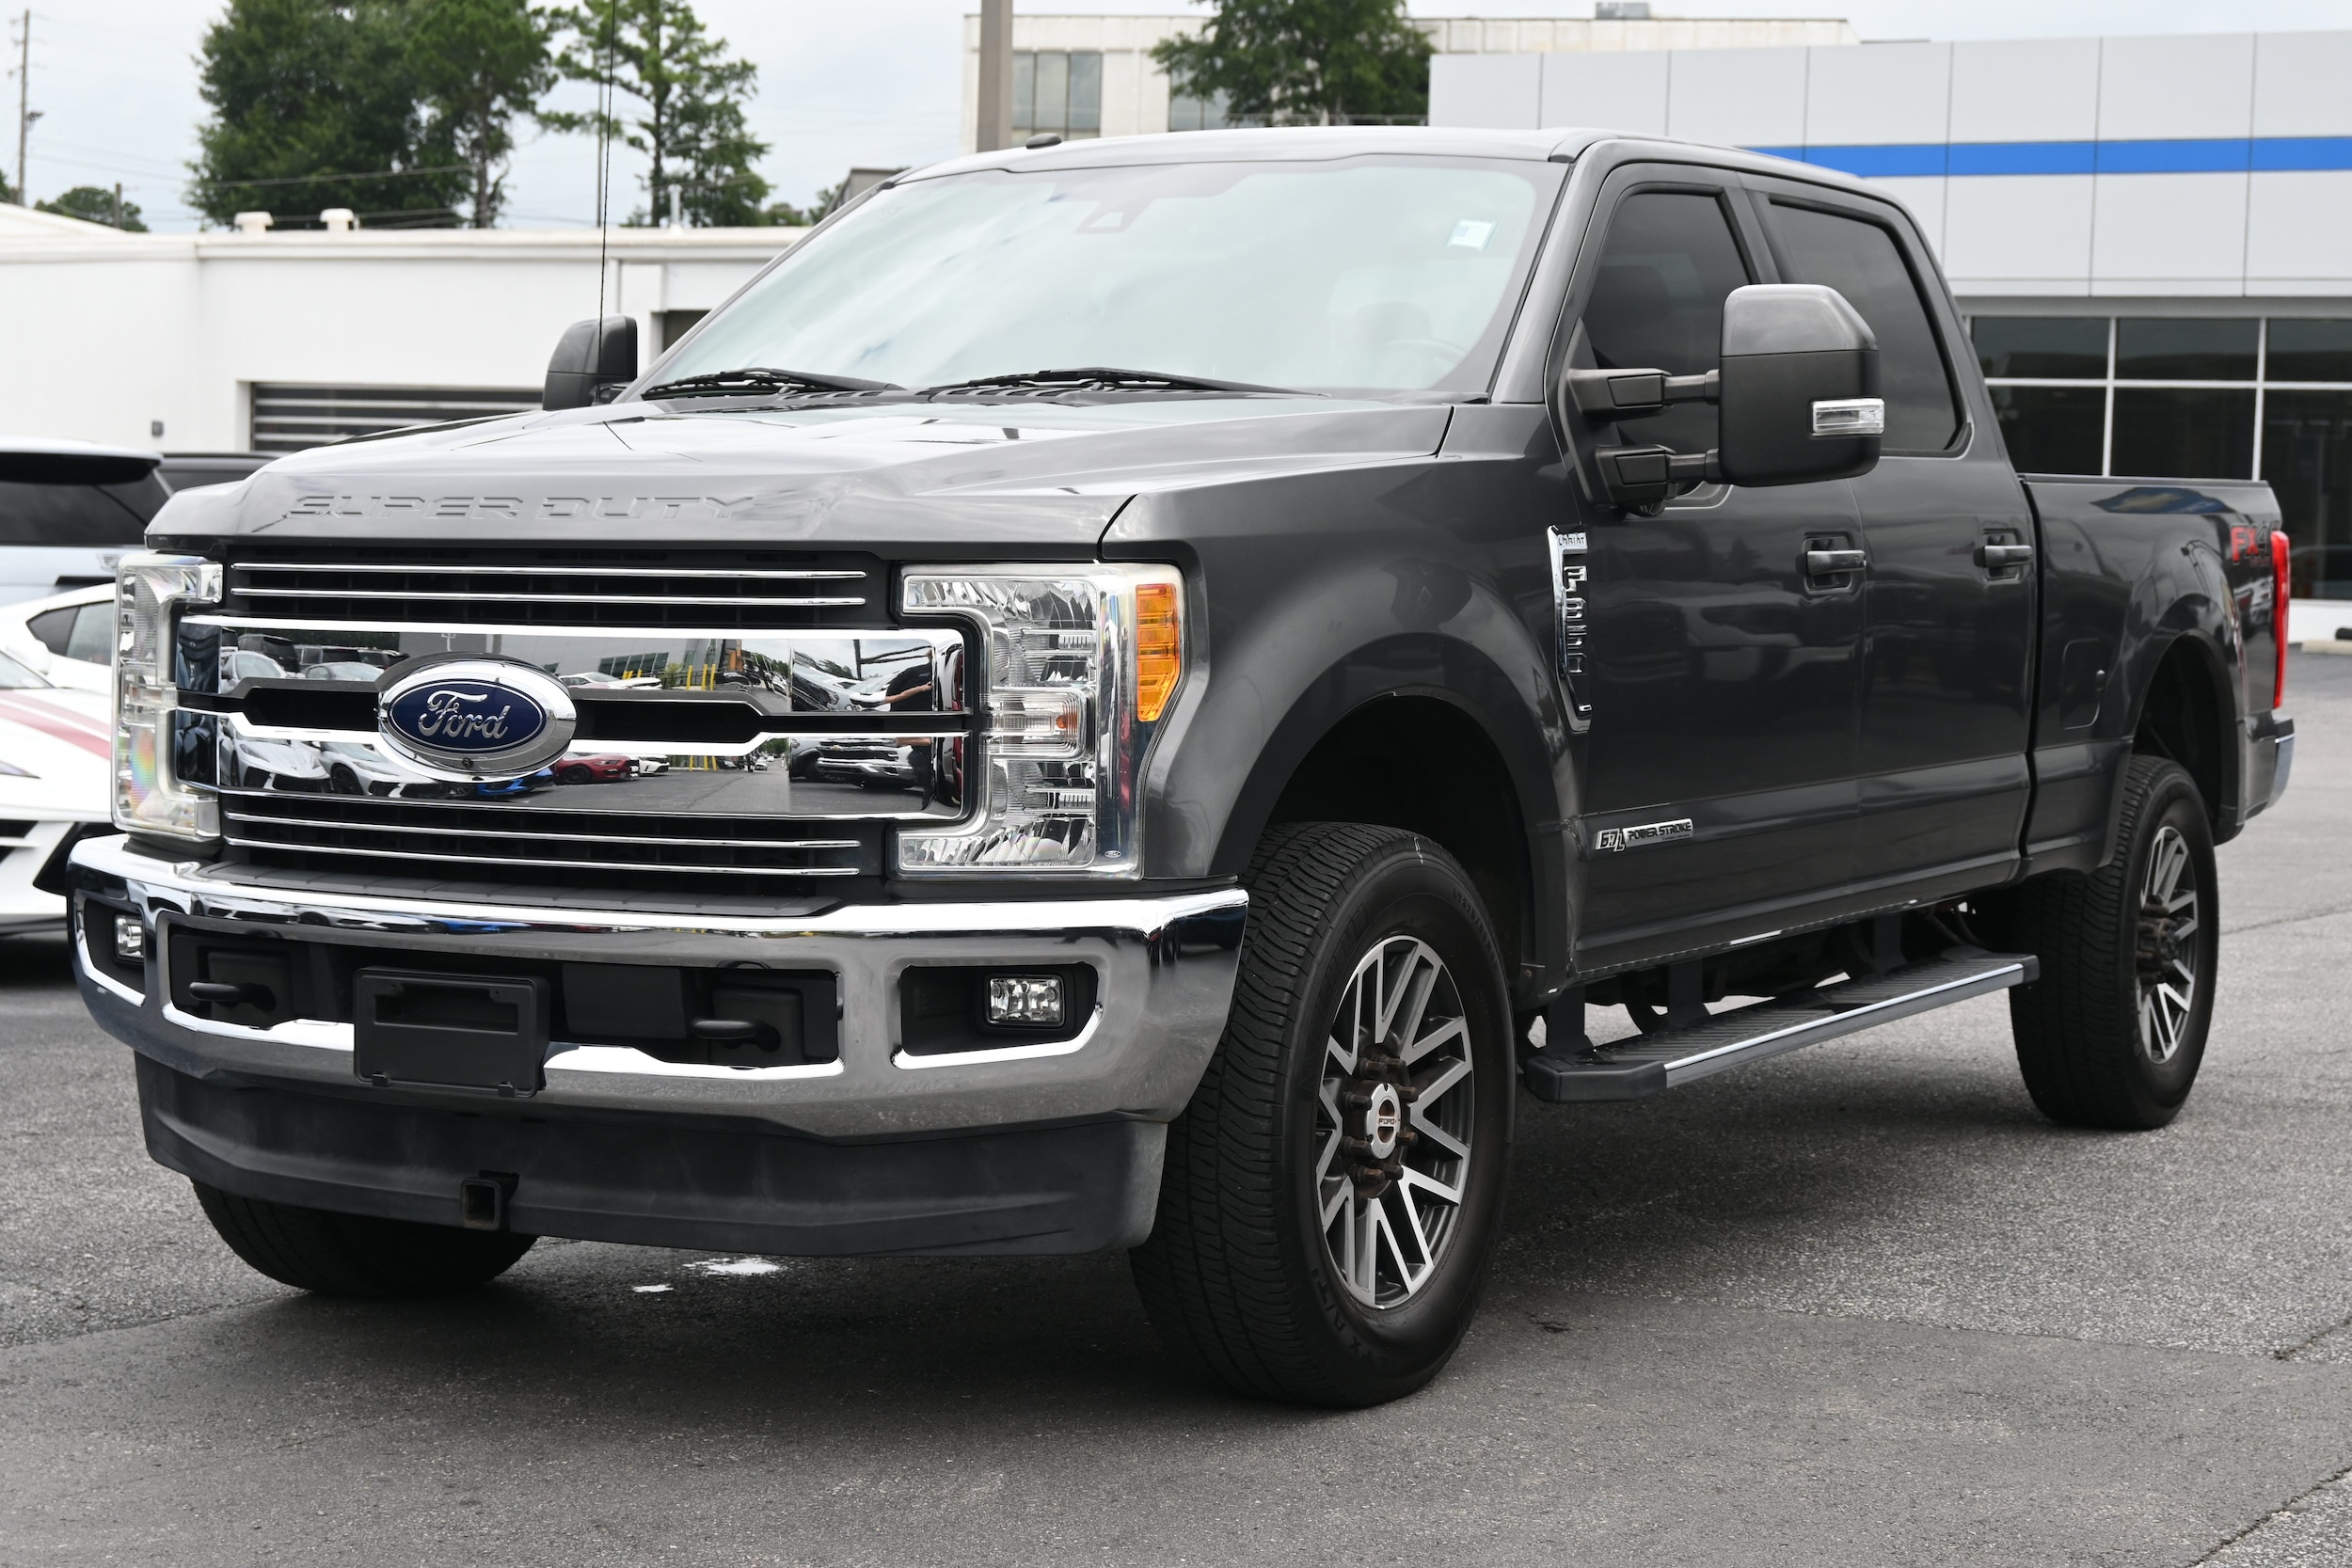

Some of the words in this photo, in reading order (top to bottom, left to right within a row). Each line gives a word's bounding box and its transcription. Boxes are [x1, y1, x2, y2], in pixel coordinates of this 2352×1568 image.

[286, 495, 524, 519] SUPER
[539, 495, 754, 519] DUTY
[2231, 524, 2269, 563] FX4
[418, 689, 512, 741] Ford
[1628, 827, 1658, 841] POWER
[1658, 821, 1692, 836] STROKE
